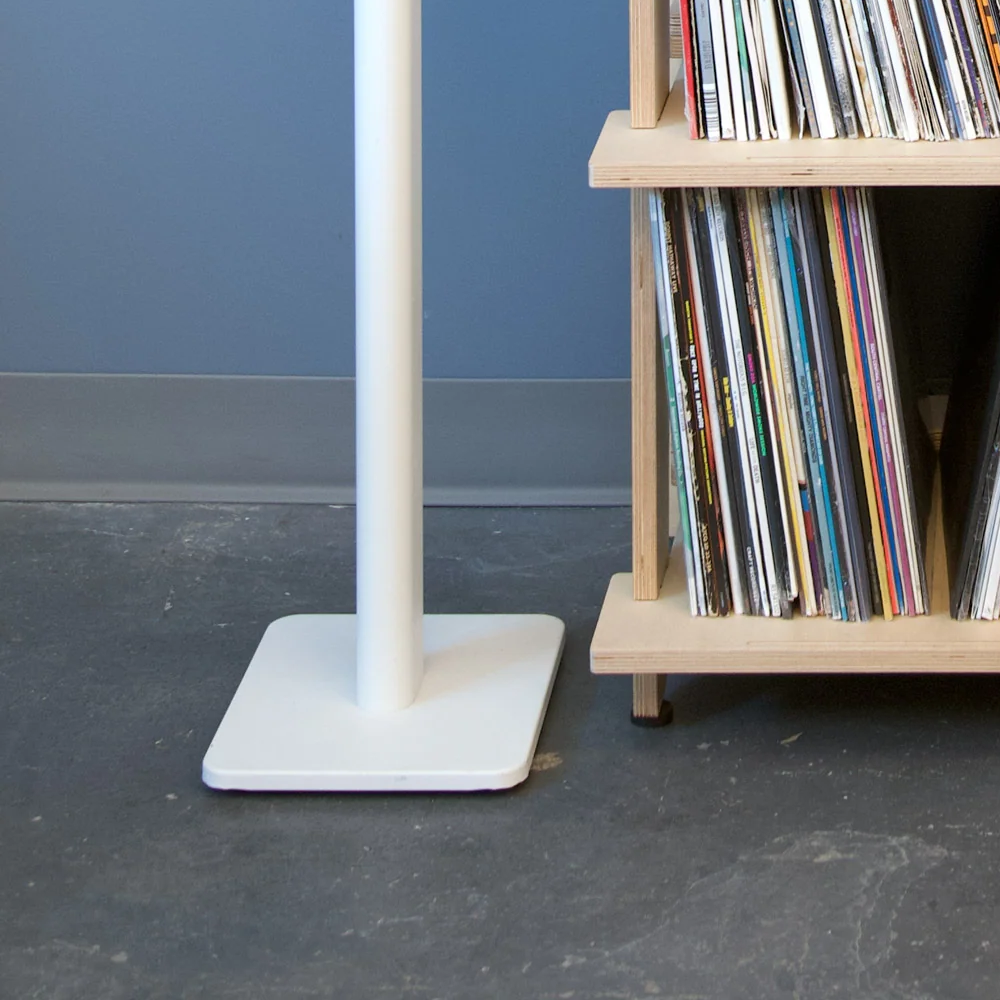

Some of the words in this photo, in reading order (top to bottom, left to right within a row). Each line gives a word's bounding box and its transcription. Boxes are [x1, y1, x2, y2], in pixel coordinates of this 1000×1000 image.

[664, 220, 672, 243] DONNY
[667, 244, 676, 279] HATHAWAY
[799, 374, 807, 393] RIGHT
[801, 393, 809, 406] TIME
[804, 410, 813, 432] MIGHTY
[807, 432, 818, 463] DIAMONDS
[752, 463, 760, 483] DEATH
[745, 545, 753, 566] CRAFT
